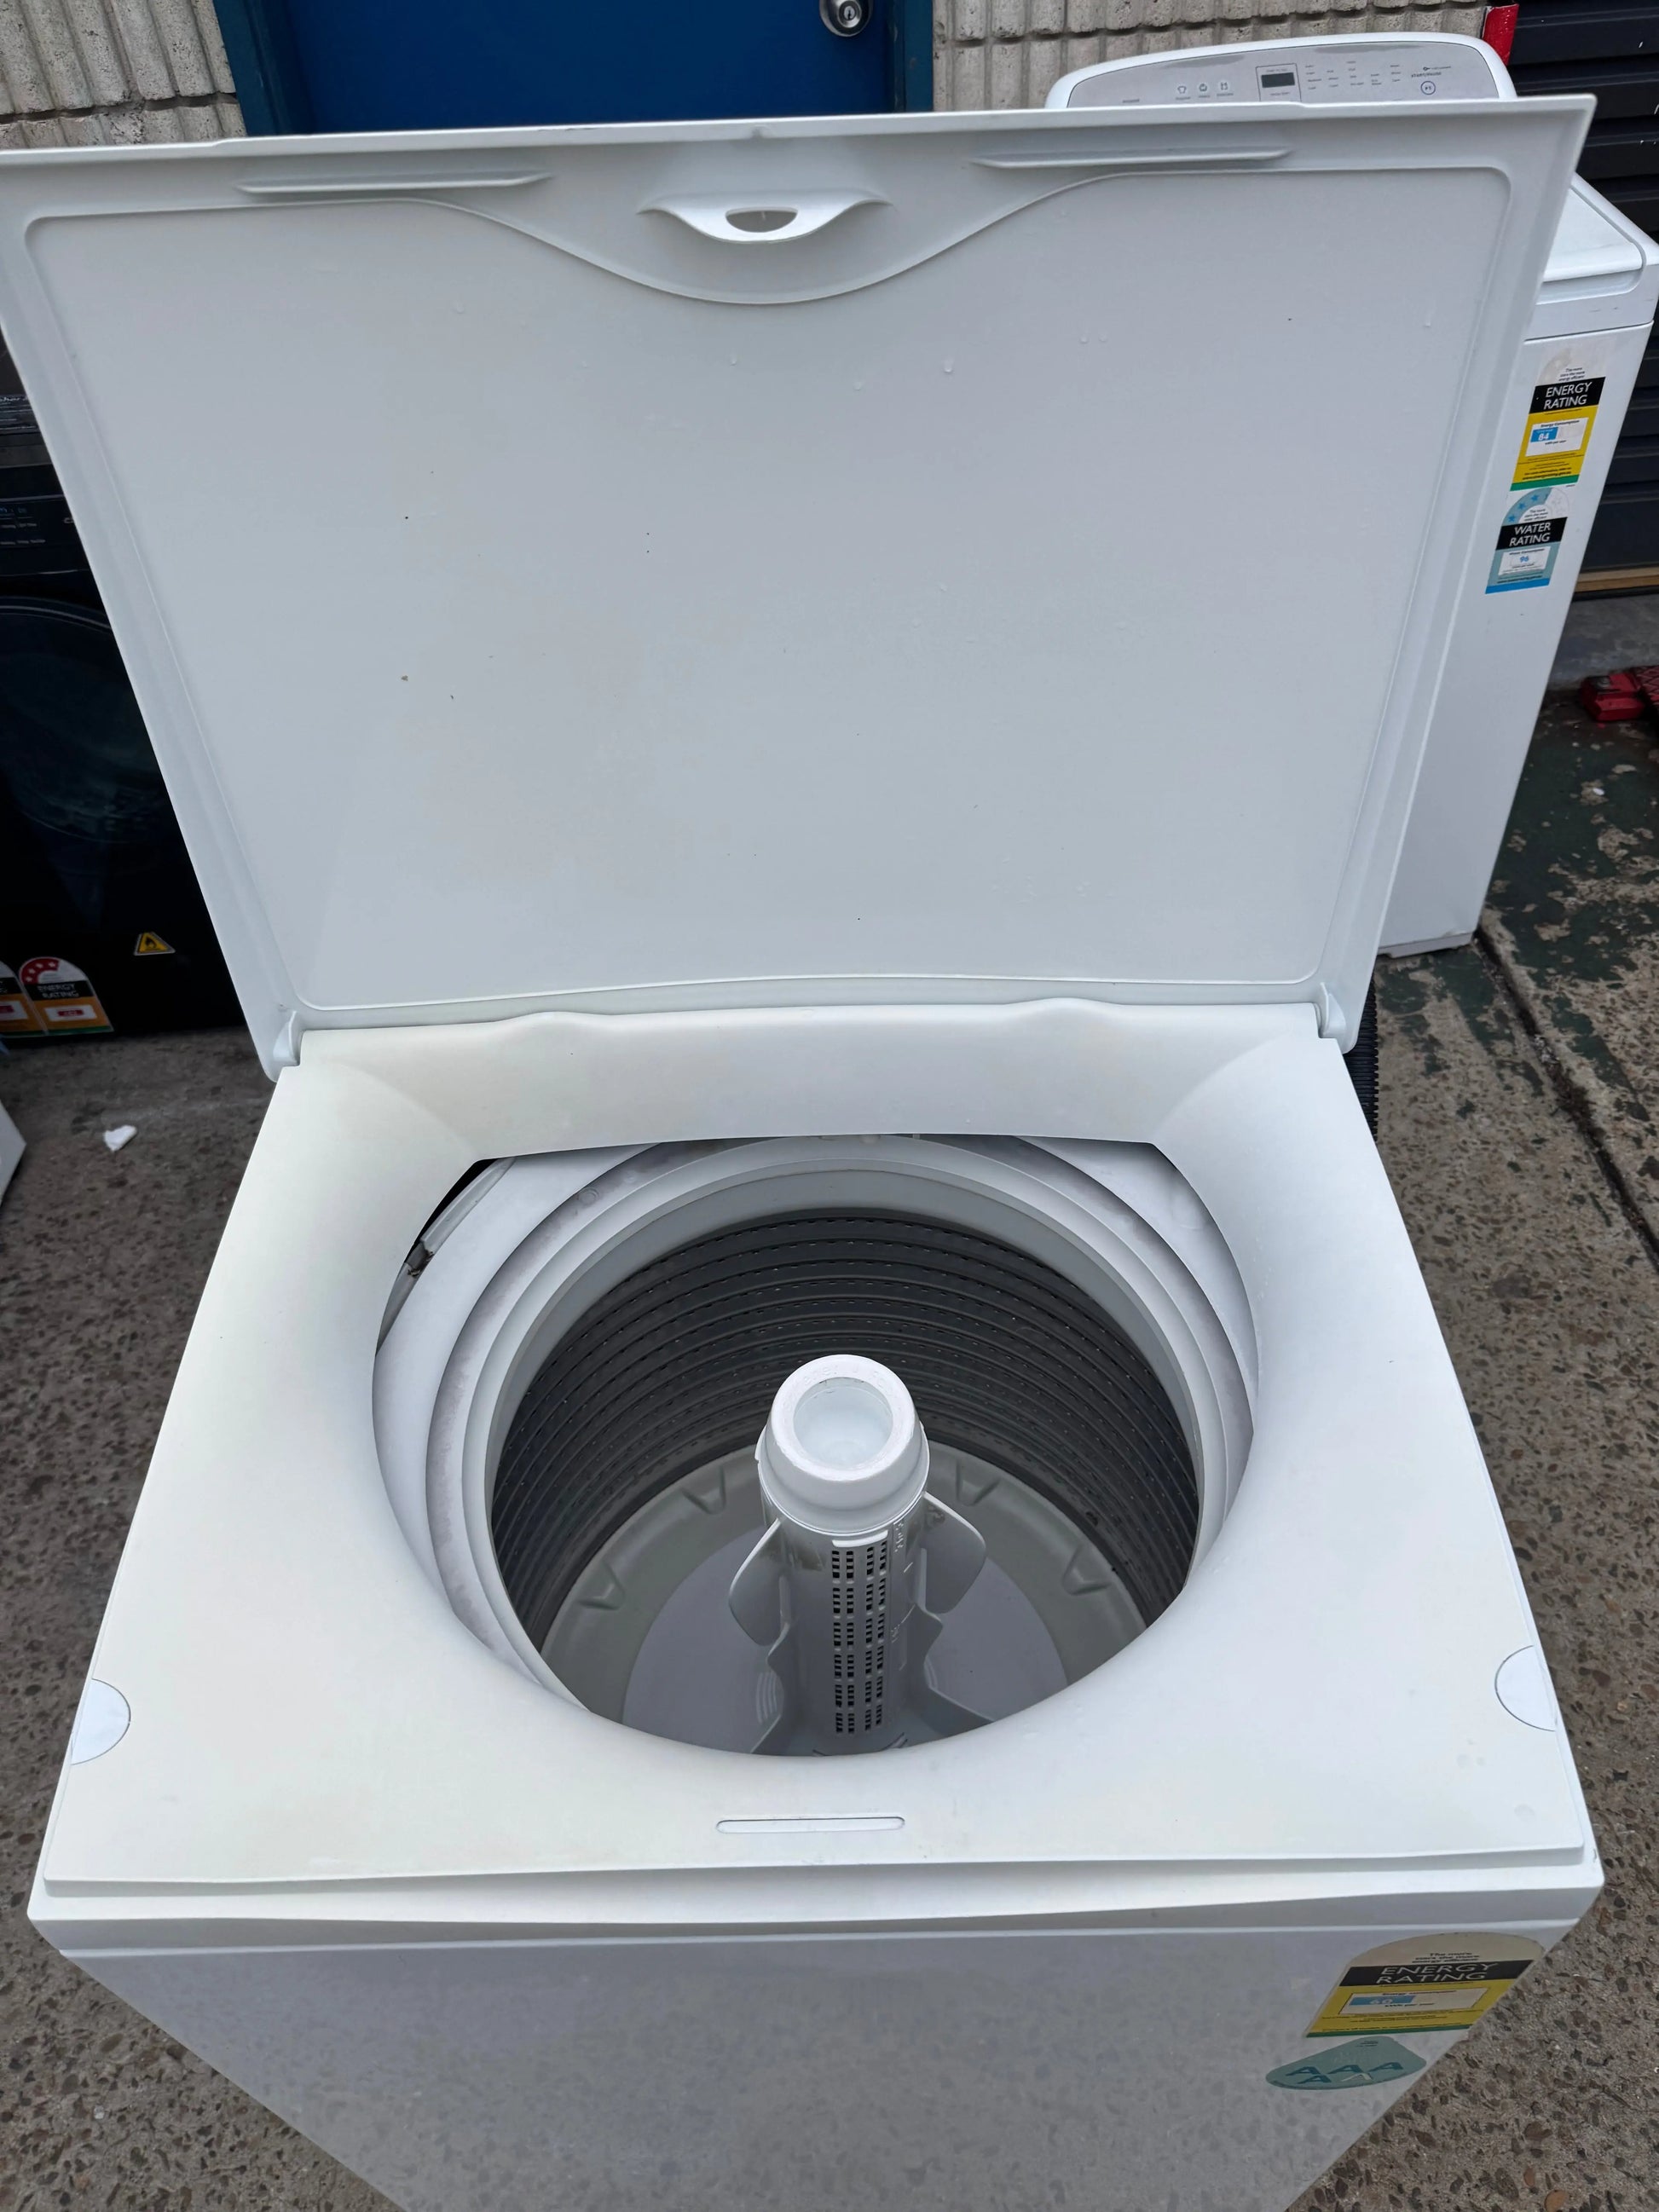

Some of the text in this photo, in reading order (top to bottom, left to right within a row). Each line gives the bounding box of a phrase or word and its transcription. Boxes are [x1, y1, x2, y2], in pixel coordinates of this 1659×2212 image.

[1546, 382, 1593, 397] ENERGY
[1543, 395, 1587, 410] RATING
[1514, 522, 1551, 535] WATER
[1509, 533, 1550, 547] RATING
[1381, 1962, 1498, 1975] ENERGY
[1376, 1972, 1487, 1984] RATING
